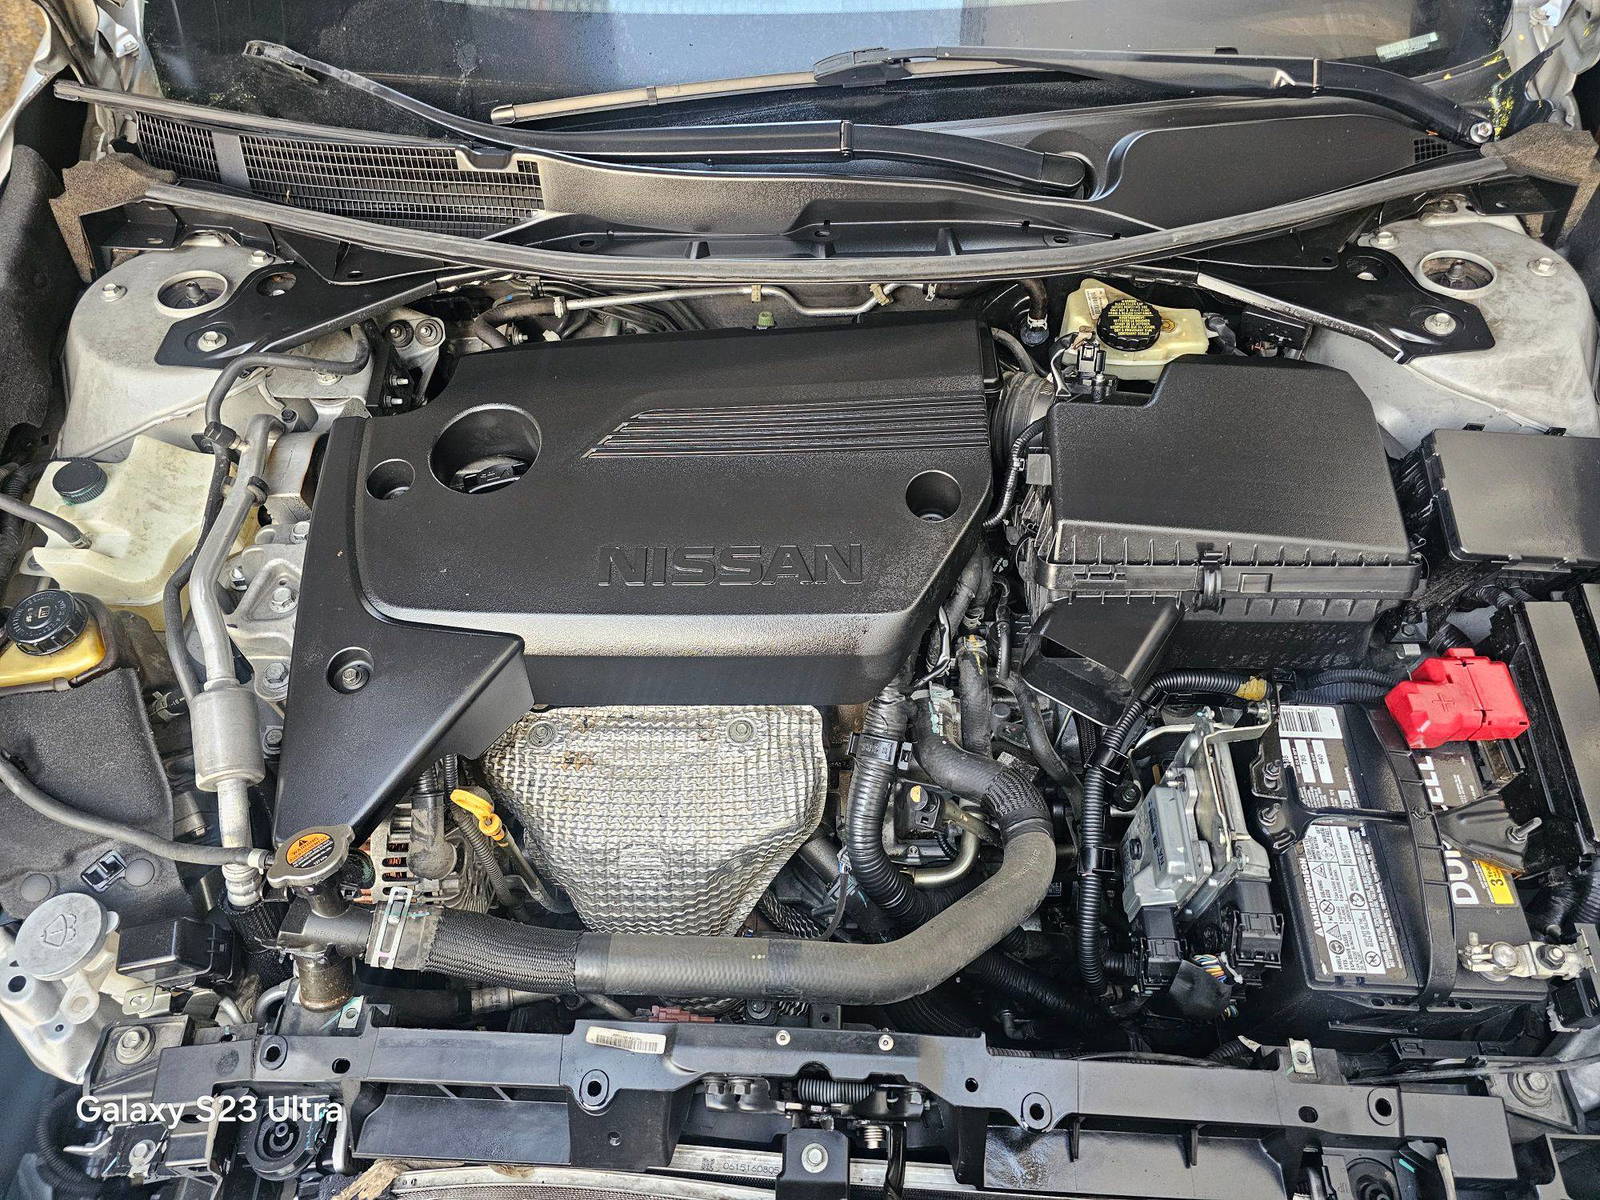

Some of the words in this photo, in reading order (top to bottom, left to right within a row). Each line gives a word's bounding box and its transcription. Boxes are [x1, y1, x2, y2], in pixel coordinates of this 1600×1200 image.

[598, 543, 863, 587] NISSAN
[1299, 857, 1321, 926] DANGER/POISON
[1490, 878, 1504, 887] 3
